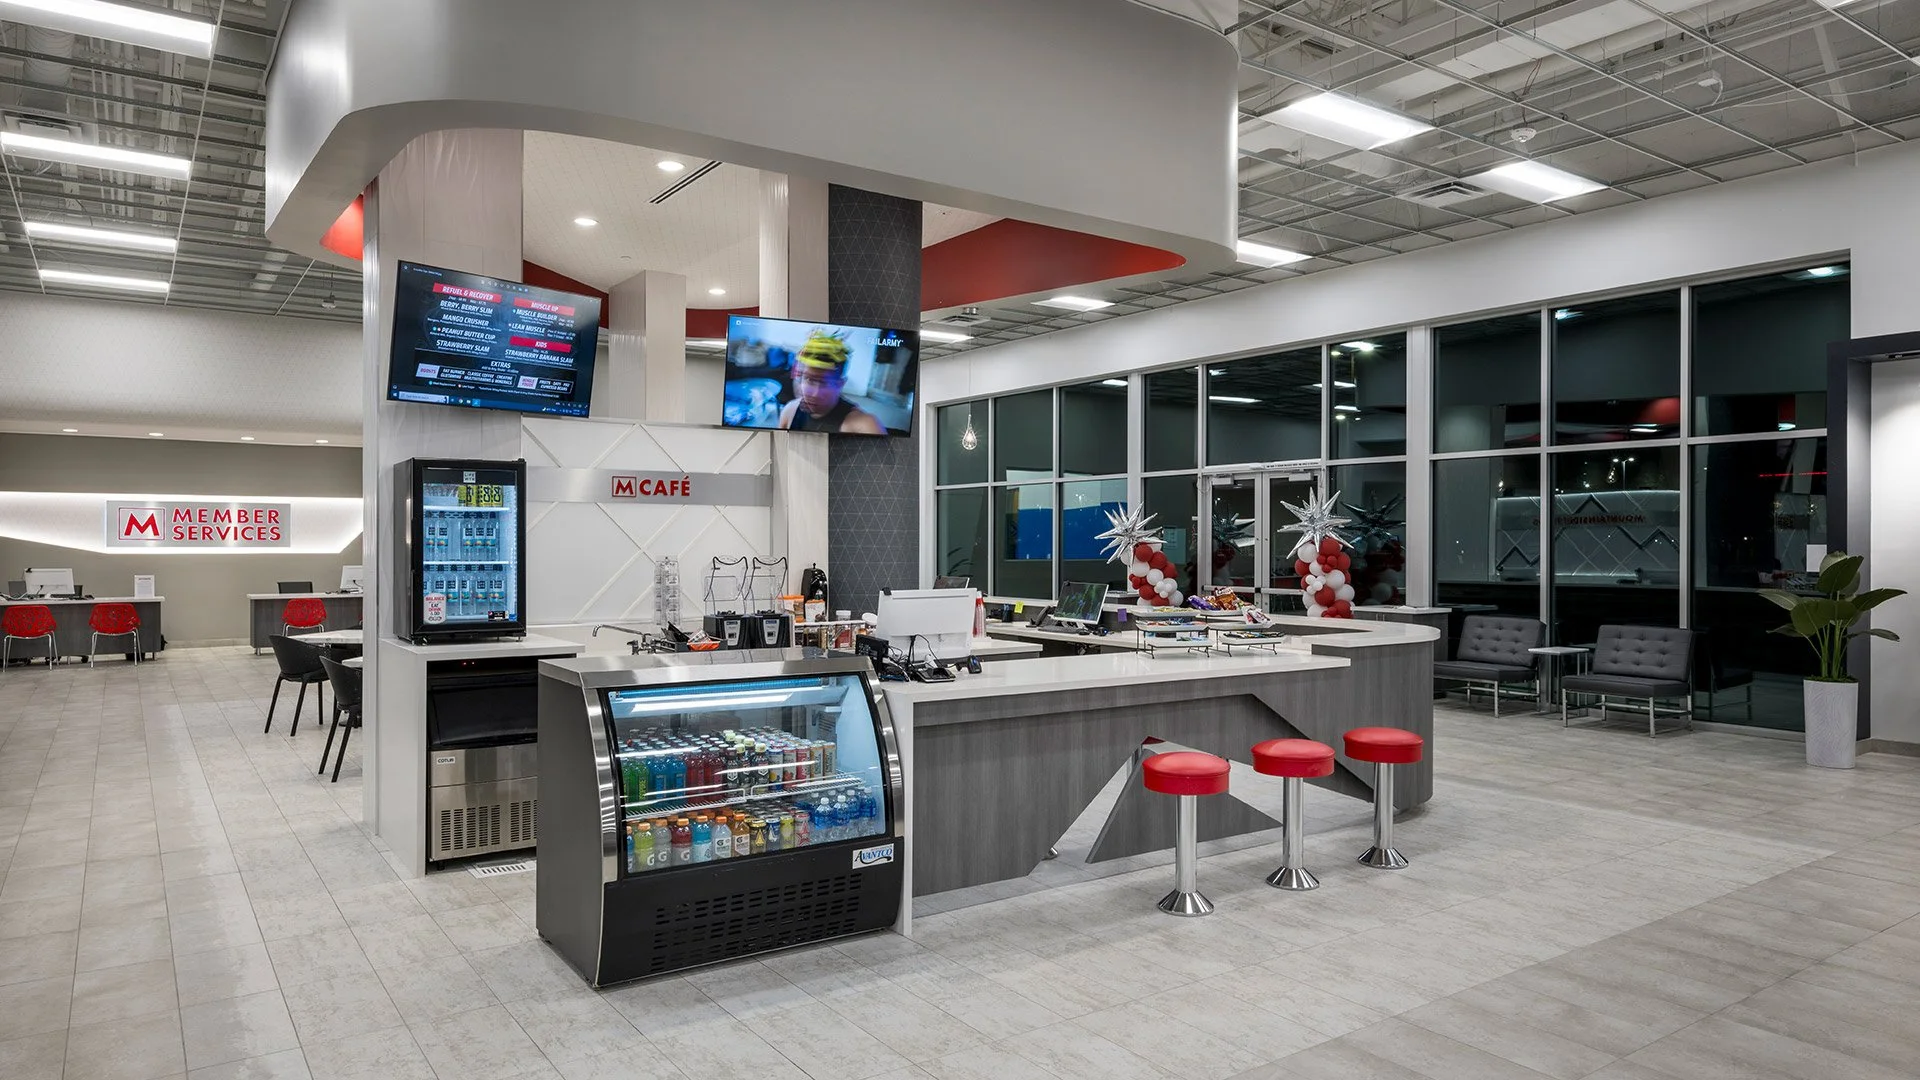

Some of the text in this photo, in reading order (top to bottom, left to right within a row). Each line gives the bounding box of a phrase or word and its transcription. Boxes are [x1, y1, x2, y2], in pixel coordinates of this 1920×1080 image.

[442, 286, 462, 295] REFUEL
[469, 291, 494, 300] RECOVER
[440, 300, 460, 309] BERRY,
[461, 304, 479, 312] BERRY
[531, 302, 550, 310] MUSCLE
[442, 314, 463, 323] MANGO
[464, 318, 489, 326] CRUSHER
[516, 309, 558, 320] MUSCLE BUILDER
[441, 327, 464, 336] PEANUT
[464, 330, 484, 338] BUTTER
[436, 340, 474, 350] STRAWBERRY
[505, 349, 538, 359] STRAWBERRY
[615, 476, 690, 496] M CAFÉ
[173, 508, 280, 524] MEMBER
[124, 512, 160, 536] M
[173, 526, 281, 541] SERVICES
[647, 853, 655, 866] G
[658, 851, 667, 861] G
[855, 848, 892, 864] AVANTCO
